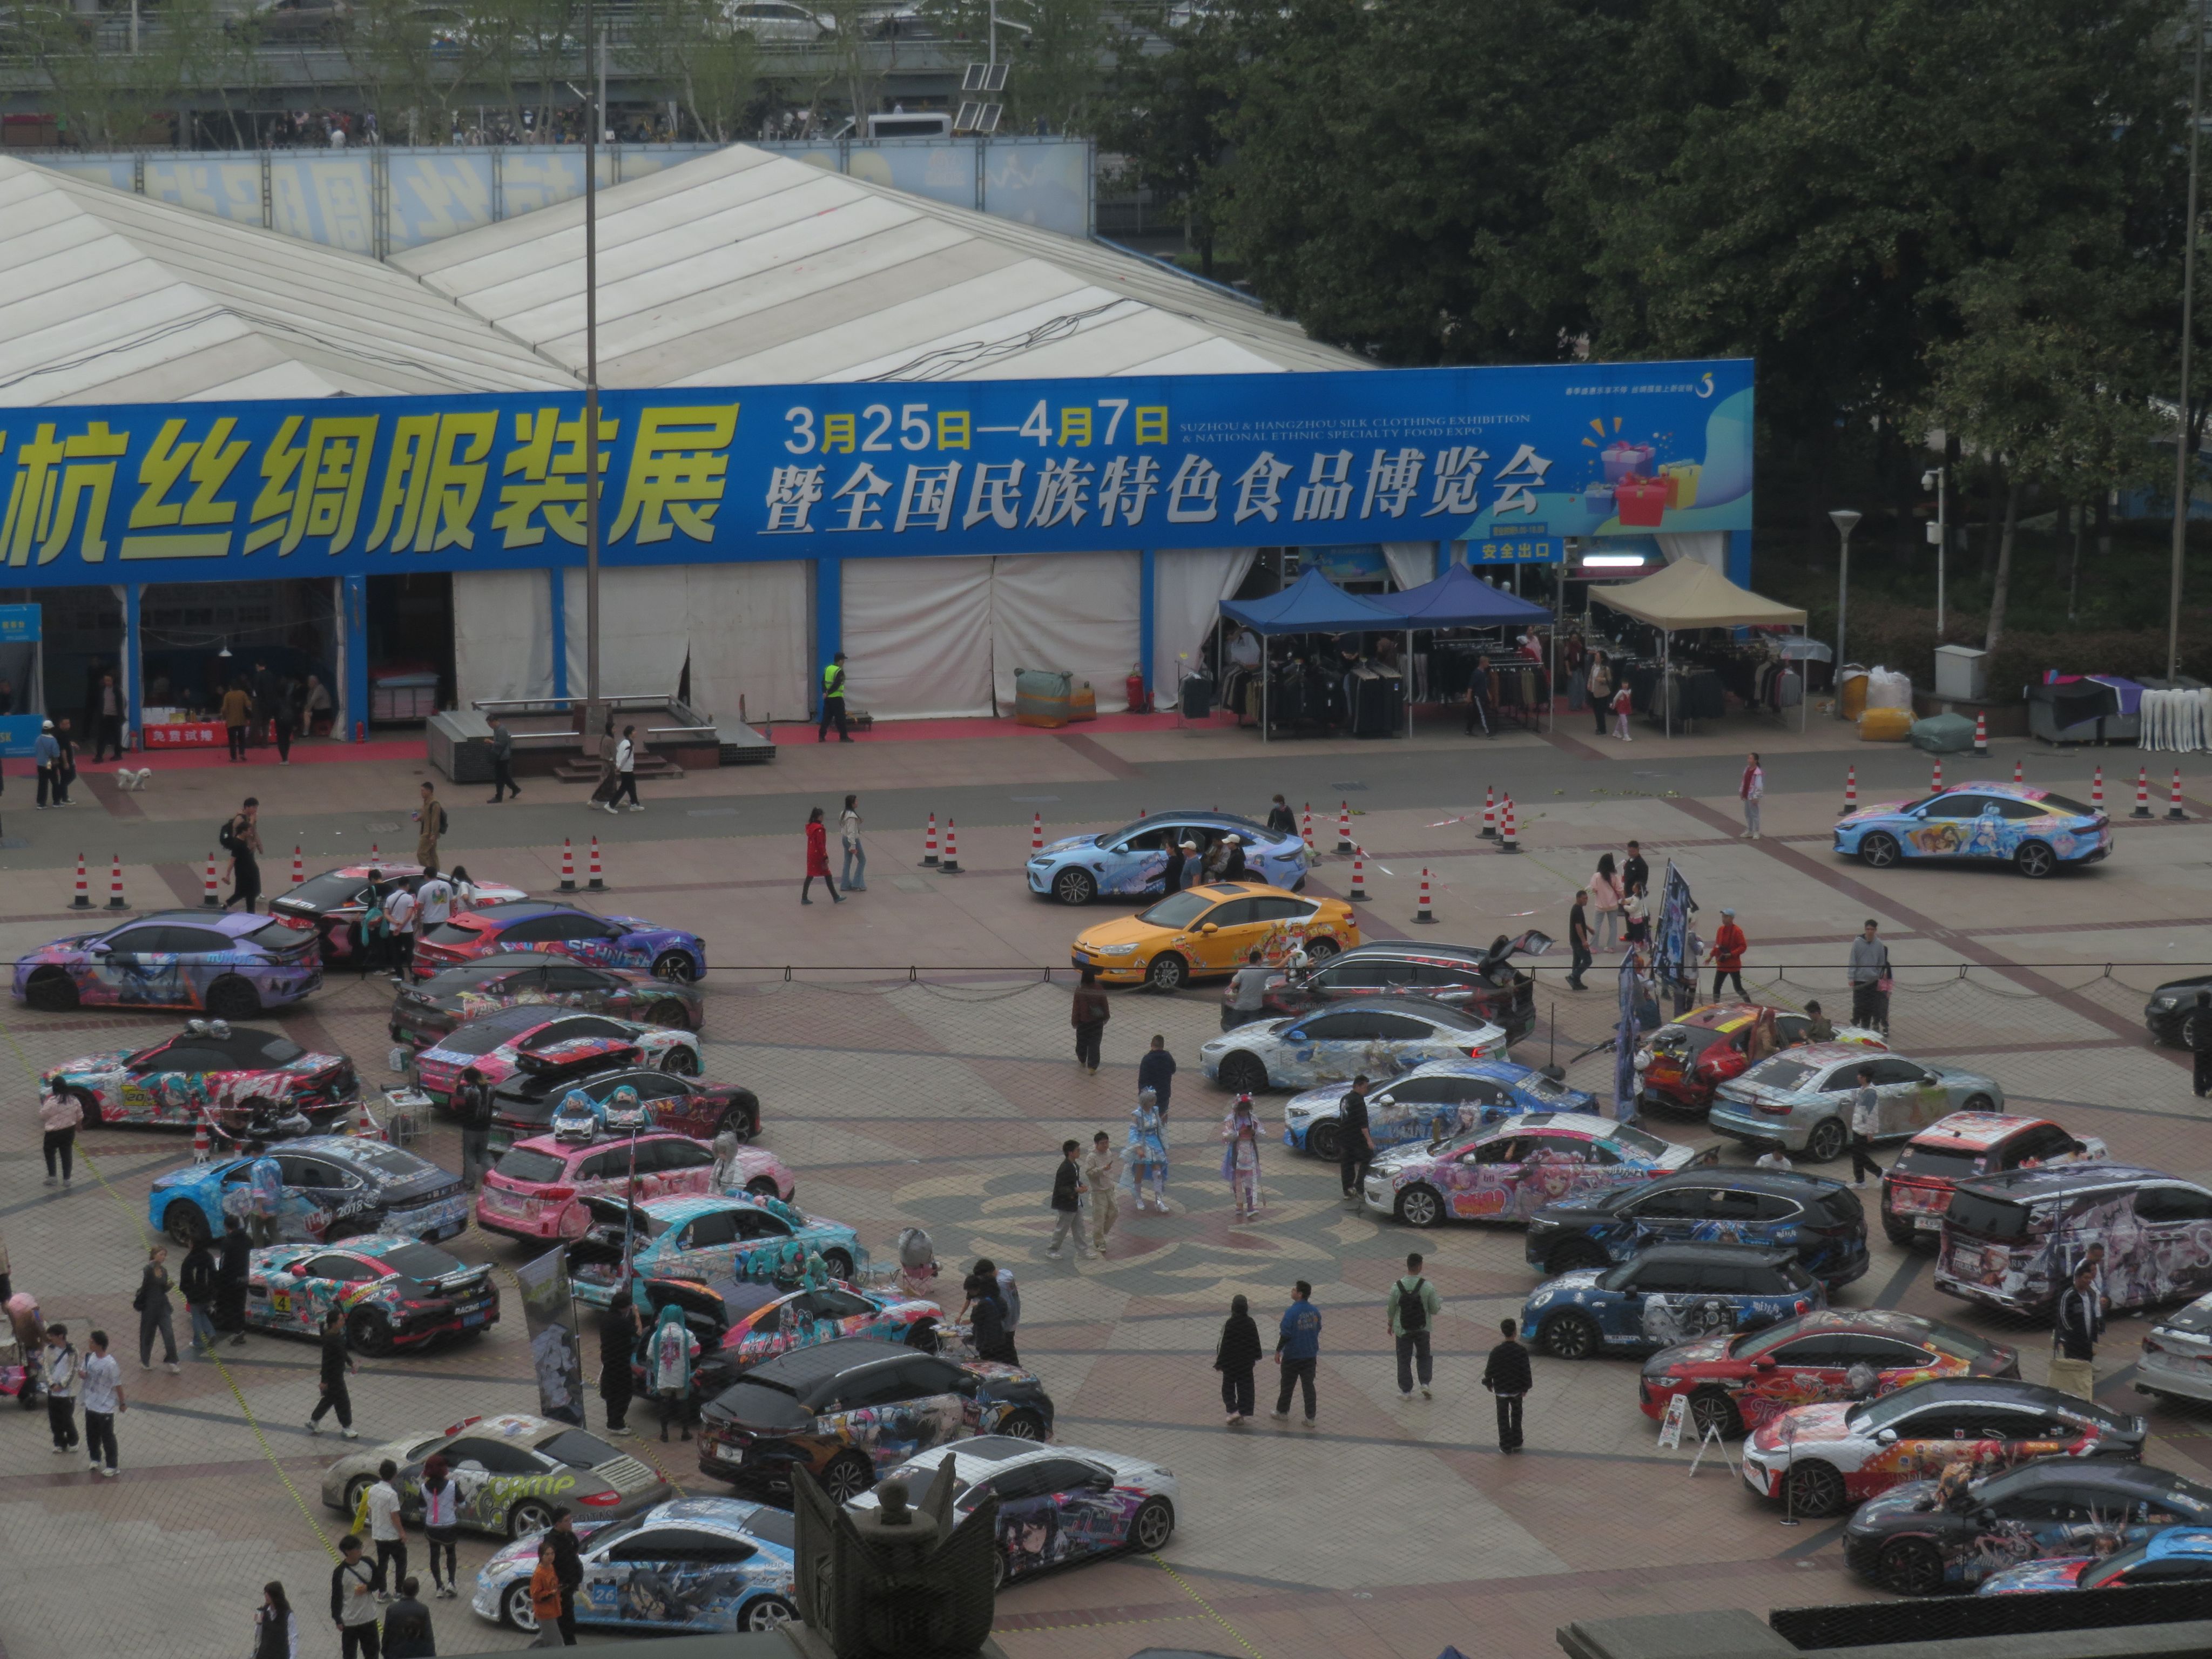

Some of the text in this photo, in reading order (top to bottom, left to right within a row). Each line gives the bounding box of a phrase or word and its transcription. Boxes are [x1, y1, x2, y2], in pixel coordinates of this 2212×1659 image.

[1180, 422, 1239, 431] SUZHOU
[1255, 420, 1337, 430] HANGZHOU
[1340, 419, 1368, 428] SILK
[1372, 417, 1446, 427] CLOTHING
[1449, 415, 1530, 424] EXHIBITION
[1195, 433, 1269, 442] NATIONAL
[1272, 431, 1325, 441] ETHNIC
[1327, 429, 1399, 440] SPECIALTY
[1404, 428, 1444, 437] FOOD
[1447, 426, 1482, 436] EXPO
[0, 402, 742, 567] 杭丝绸服装展
[756, 443, 1553, 535] 暨全国民族特色食品博览会
[1482, 543, 1549, 559] 安全出口
[126, 1093, 145, 1102] 20
[336, 1199, 363, 1218] 2018
[278, 1297, 286, 1310] 4
[455, 1303, 480, 1316] RACING
[595, 1588, 615, 1602] 26
